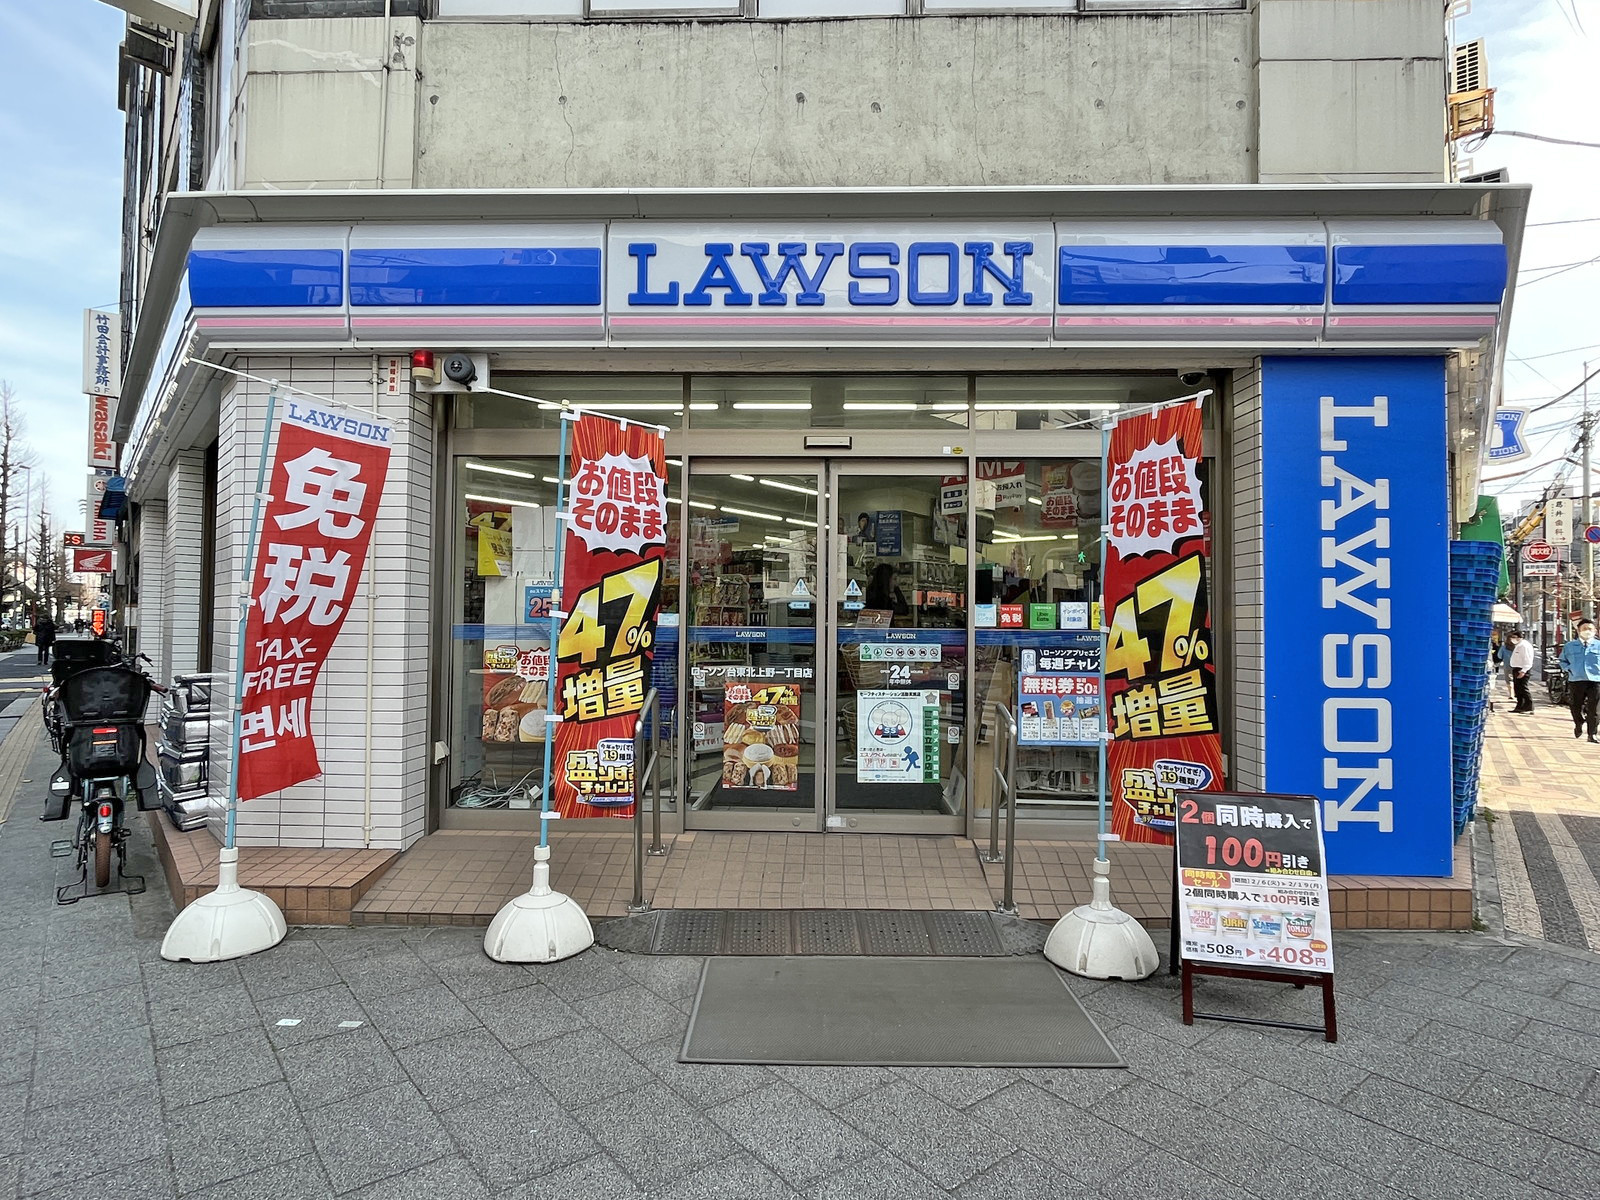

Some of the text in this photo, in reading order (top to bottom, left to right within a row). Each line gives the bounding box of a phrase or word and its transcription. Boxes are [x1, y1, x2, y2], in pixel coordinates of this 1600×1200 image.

[628, 241, 1033, 306] LAWSON
[95, 314, 111, 386] 竹田会計事務所
[289, 403, 390, 442] LAWSON
[577, 461, 660, 508] お値段
[1111, 455, 1190, 502] お値段
[572, 498, 662, 540] そのまま
[1109, 497, 1197, 539] そのまま
[259, 447, 365, 626] 免税
[1001, 613, 1022, 622] 免税
[1320, 396, 1394, 833] LAWSON
[256, 637, 317, 666] TAX-
[886, 632, 916, 640] LAWSON
[242, 662, 316, 697] FREE
[563, 654, 644, 721] 増量
[890, 664, 911, 679] 24
[1023, 676, 1075, 693] 無料券
[1076, 683, 1093, 694] 50
[1113, 668, 1213, 738] 増量
[240, 697, 307, 753] 면세
[1181, 800, 1312, 830] 2個同時購入で
[1205, 836, 1310, 869] 100円引き
[1184, 869, 1227, 881] 同時購入
[1193, 879, 1220, 888] セール
[1185, 888, 1320, 907] 2個同時購入で100円引き
[1206, 943, 1243, 956] 508円
[1267, 946, 1327, 967] 408円
